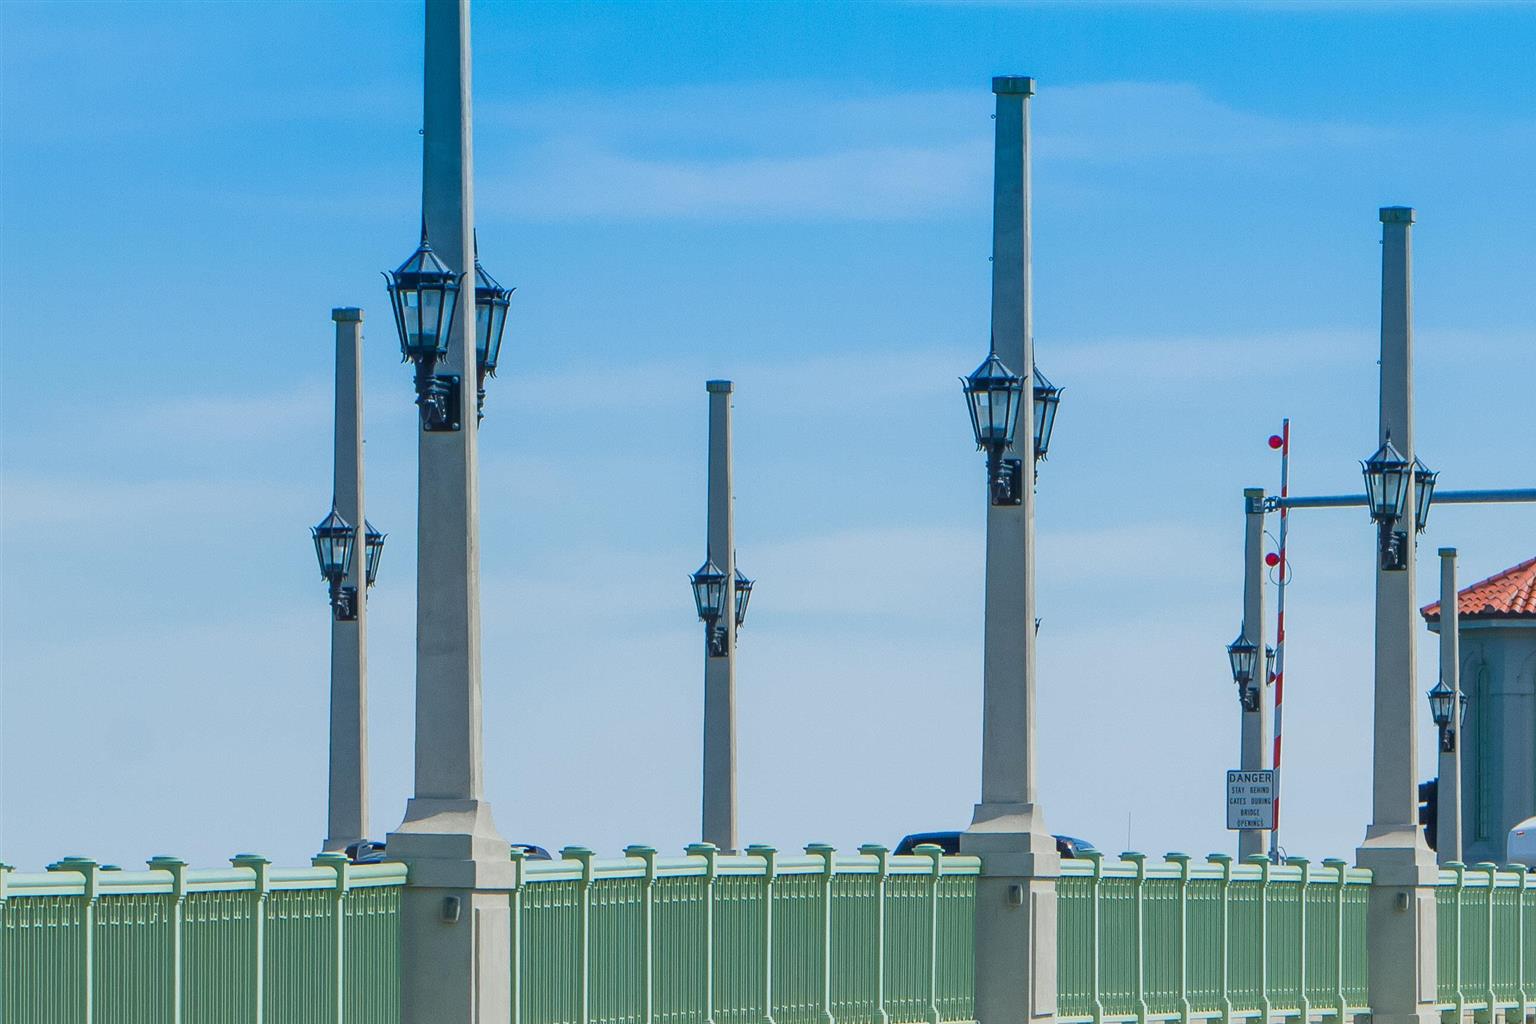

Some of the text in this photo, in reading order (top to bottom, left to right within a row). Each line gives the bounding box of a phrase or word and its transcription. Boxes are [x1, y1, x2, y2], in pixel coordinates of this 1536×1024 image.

[1229, 773, 1271, 783] DANGER
[1231, 786, 1269, 794] STAY BEHIND
[1240, 808, 1260, 817] BRIDGE
